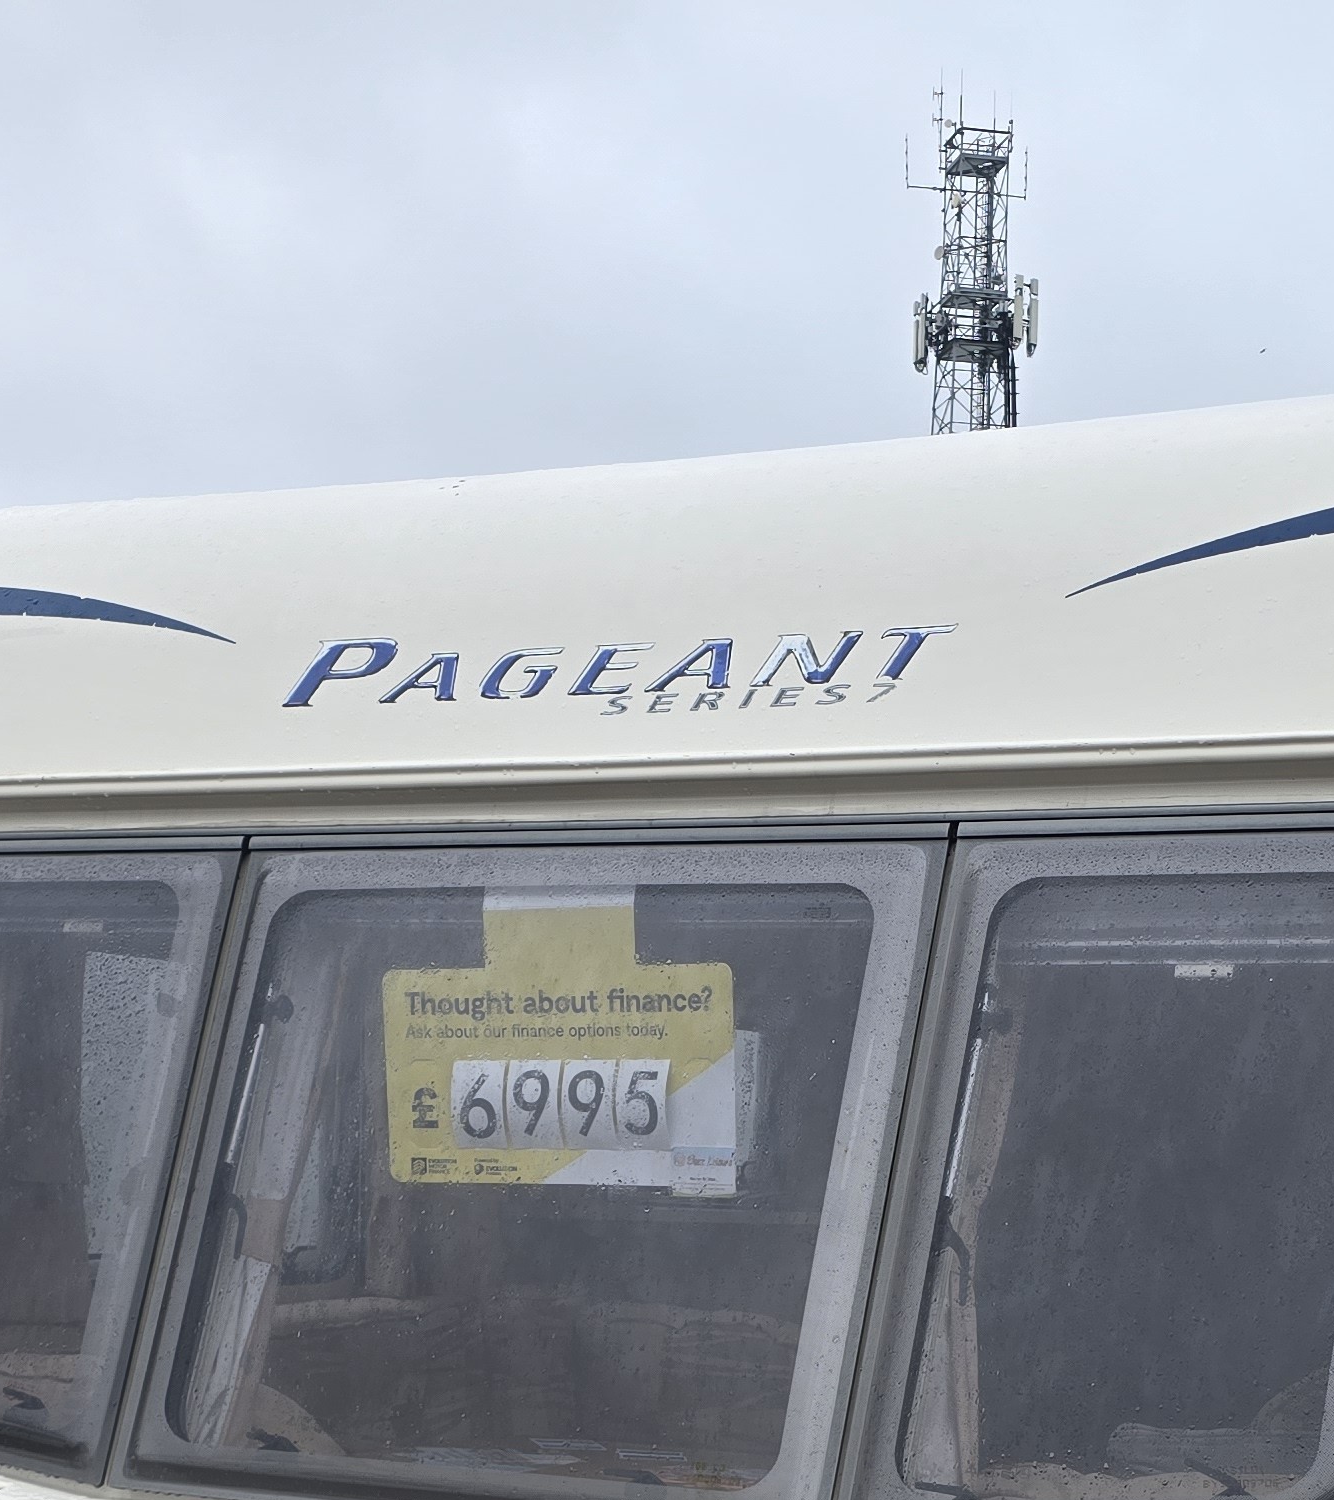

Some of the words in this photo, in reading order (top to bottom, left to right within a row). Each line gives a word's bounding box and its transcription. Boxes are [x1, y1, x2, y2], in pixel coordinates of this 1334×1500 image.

[282, 623, 959, 708] PAGEANT
[404, 990, 515, 1021] Thought
[522, 988, 598, 1016] about
[607, 986, 713, 1014] finance?
[405, 1023, 432, 1039] Ask
[436, 1023, 478, 1039] about
[483, 1026, 506, 1039] our
[512, 1023, 564, 1038] finance
[569, 1023, 621, 1041] options
